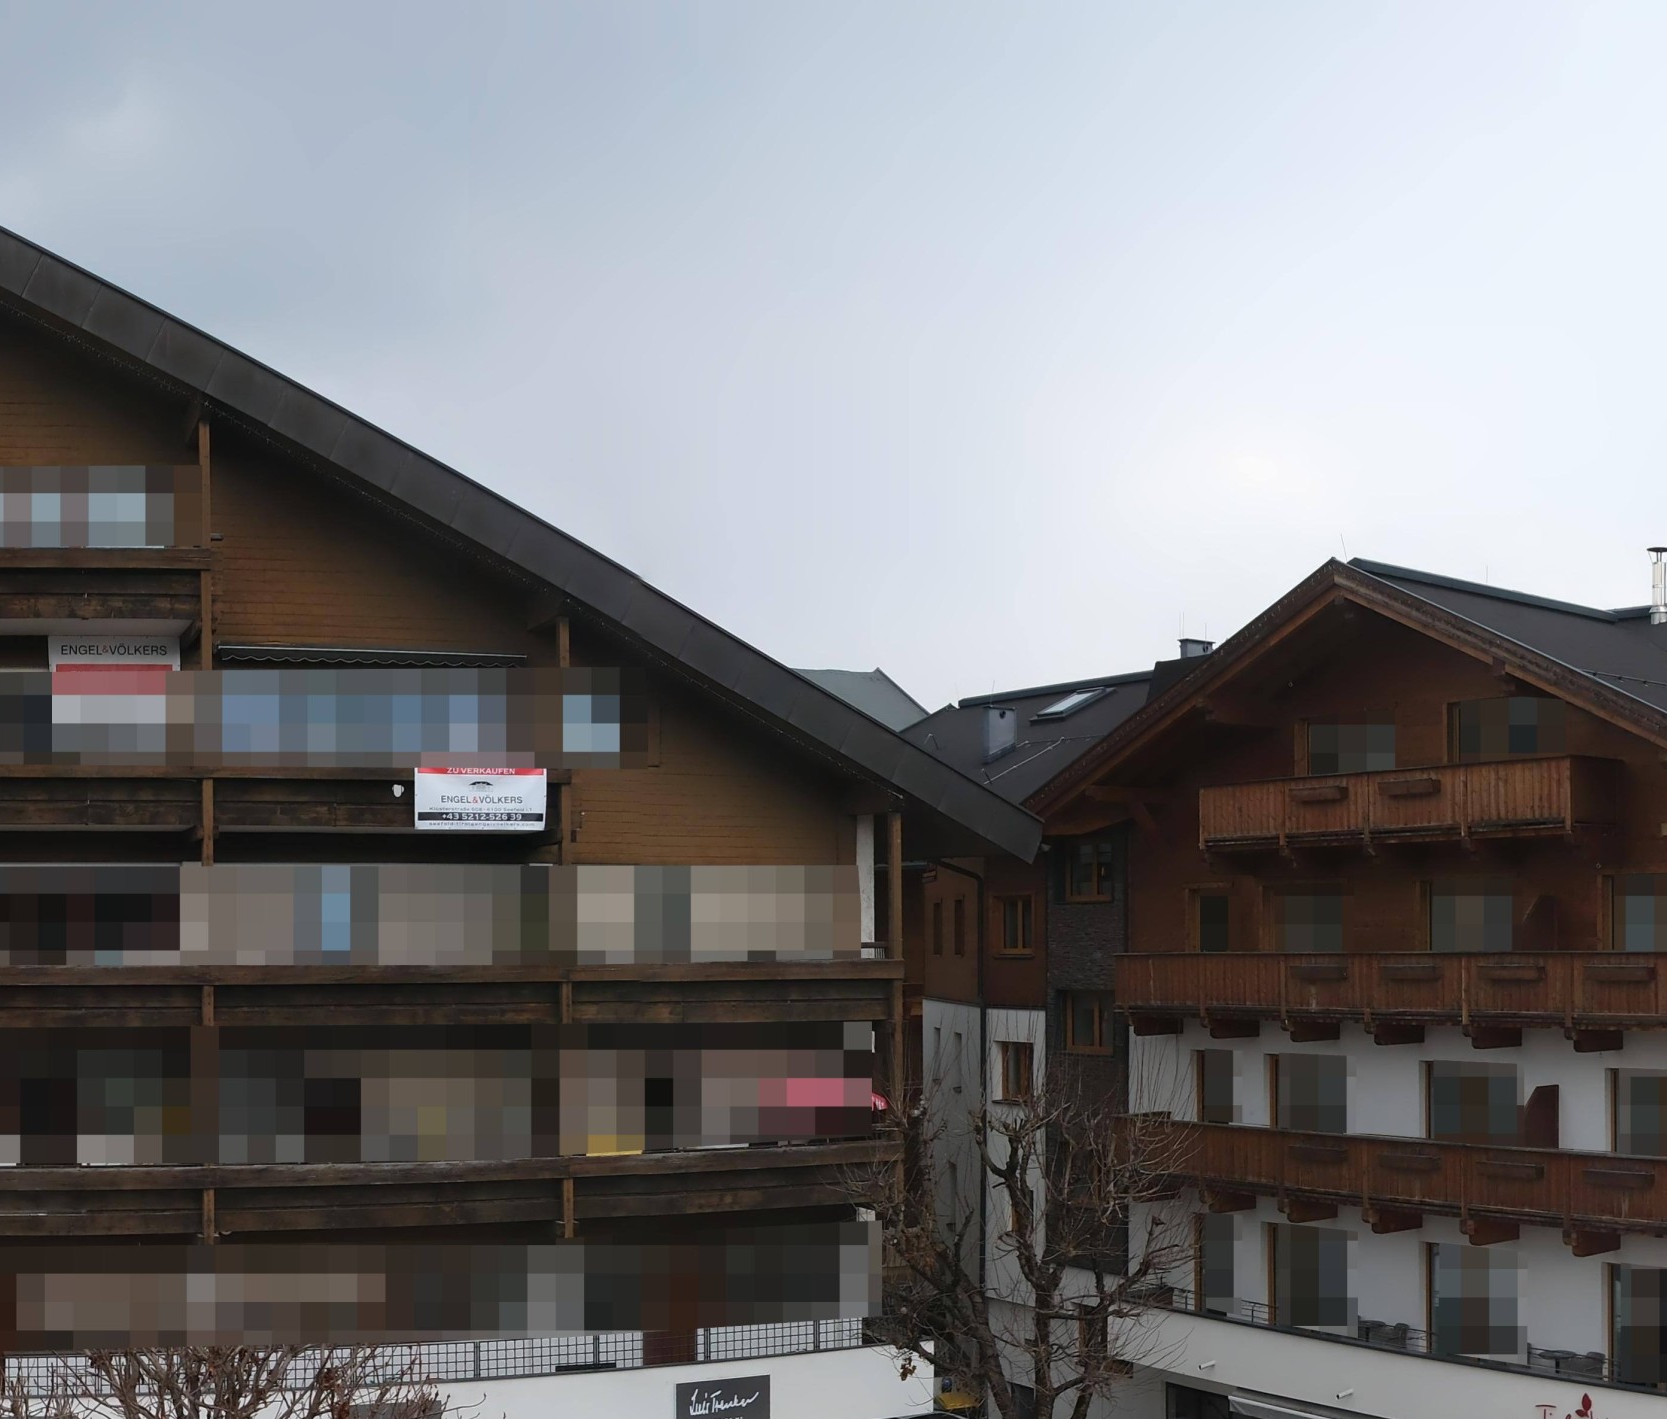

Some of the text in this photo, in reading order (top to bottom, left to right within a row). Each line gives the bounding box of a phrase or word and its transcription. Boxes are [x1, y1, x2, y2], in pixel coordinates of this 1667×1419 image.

[61, 643, 167, 655] ENGEL&VÖLKERS
[461, 767, 516, 775] VERKAUFEN
[440, 794, 523, 804] ENGEL&VÖLKERS
